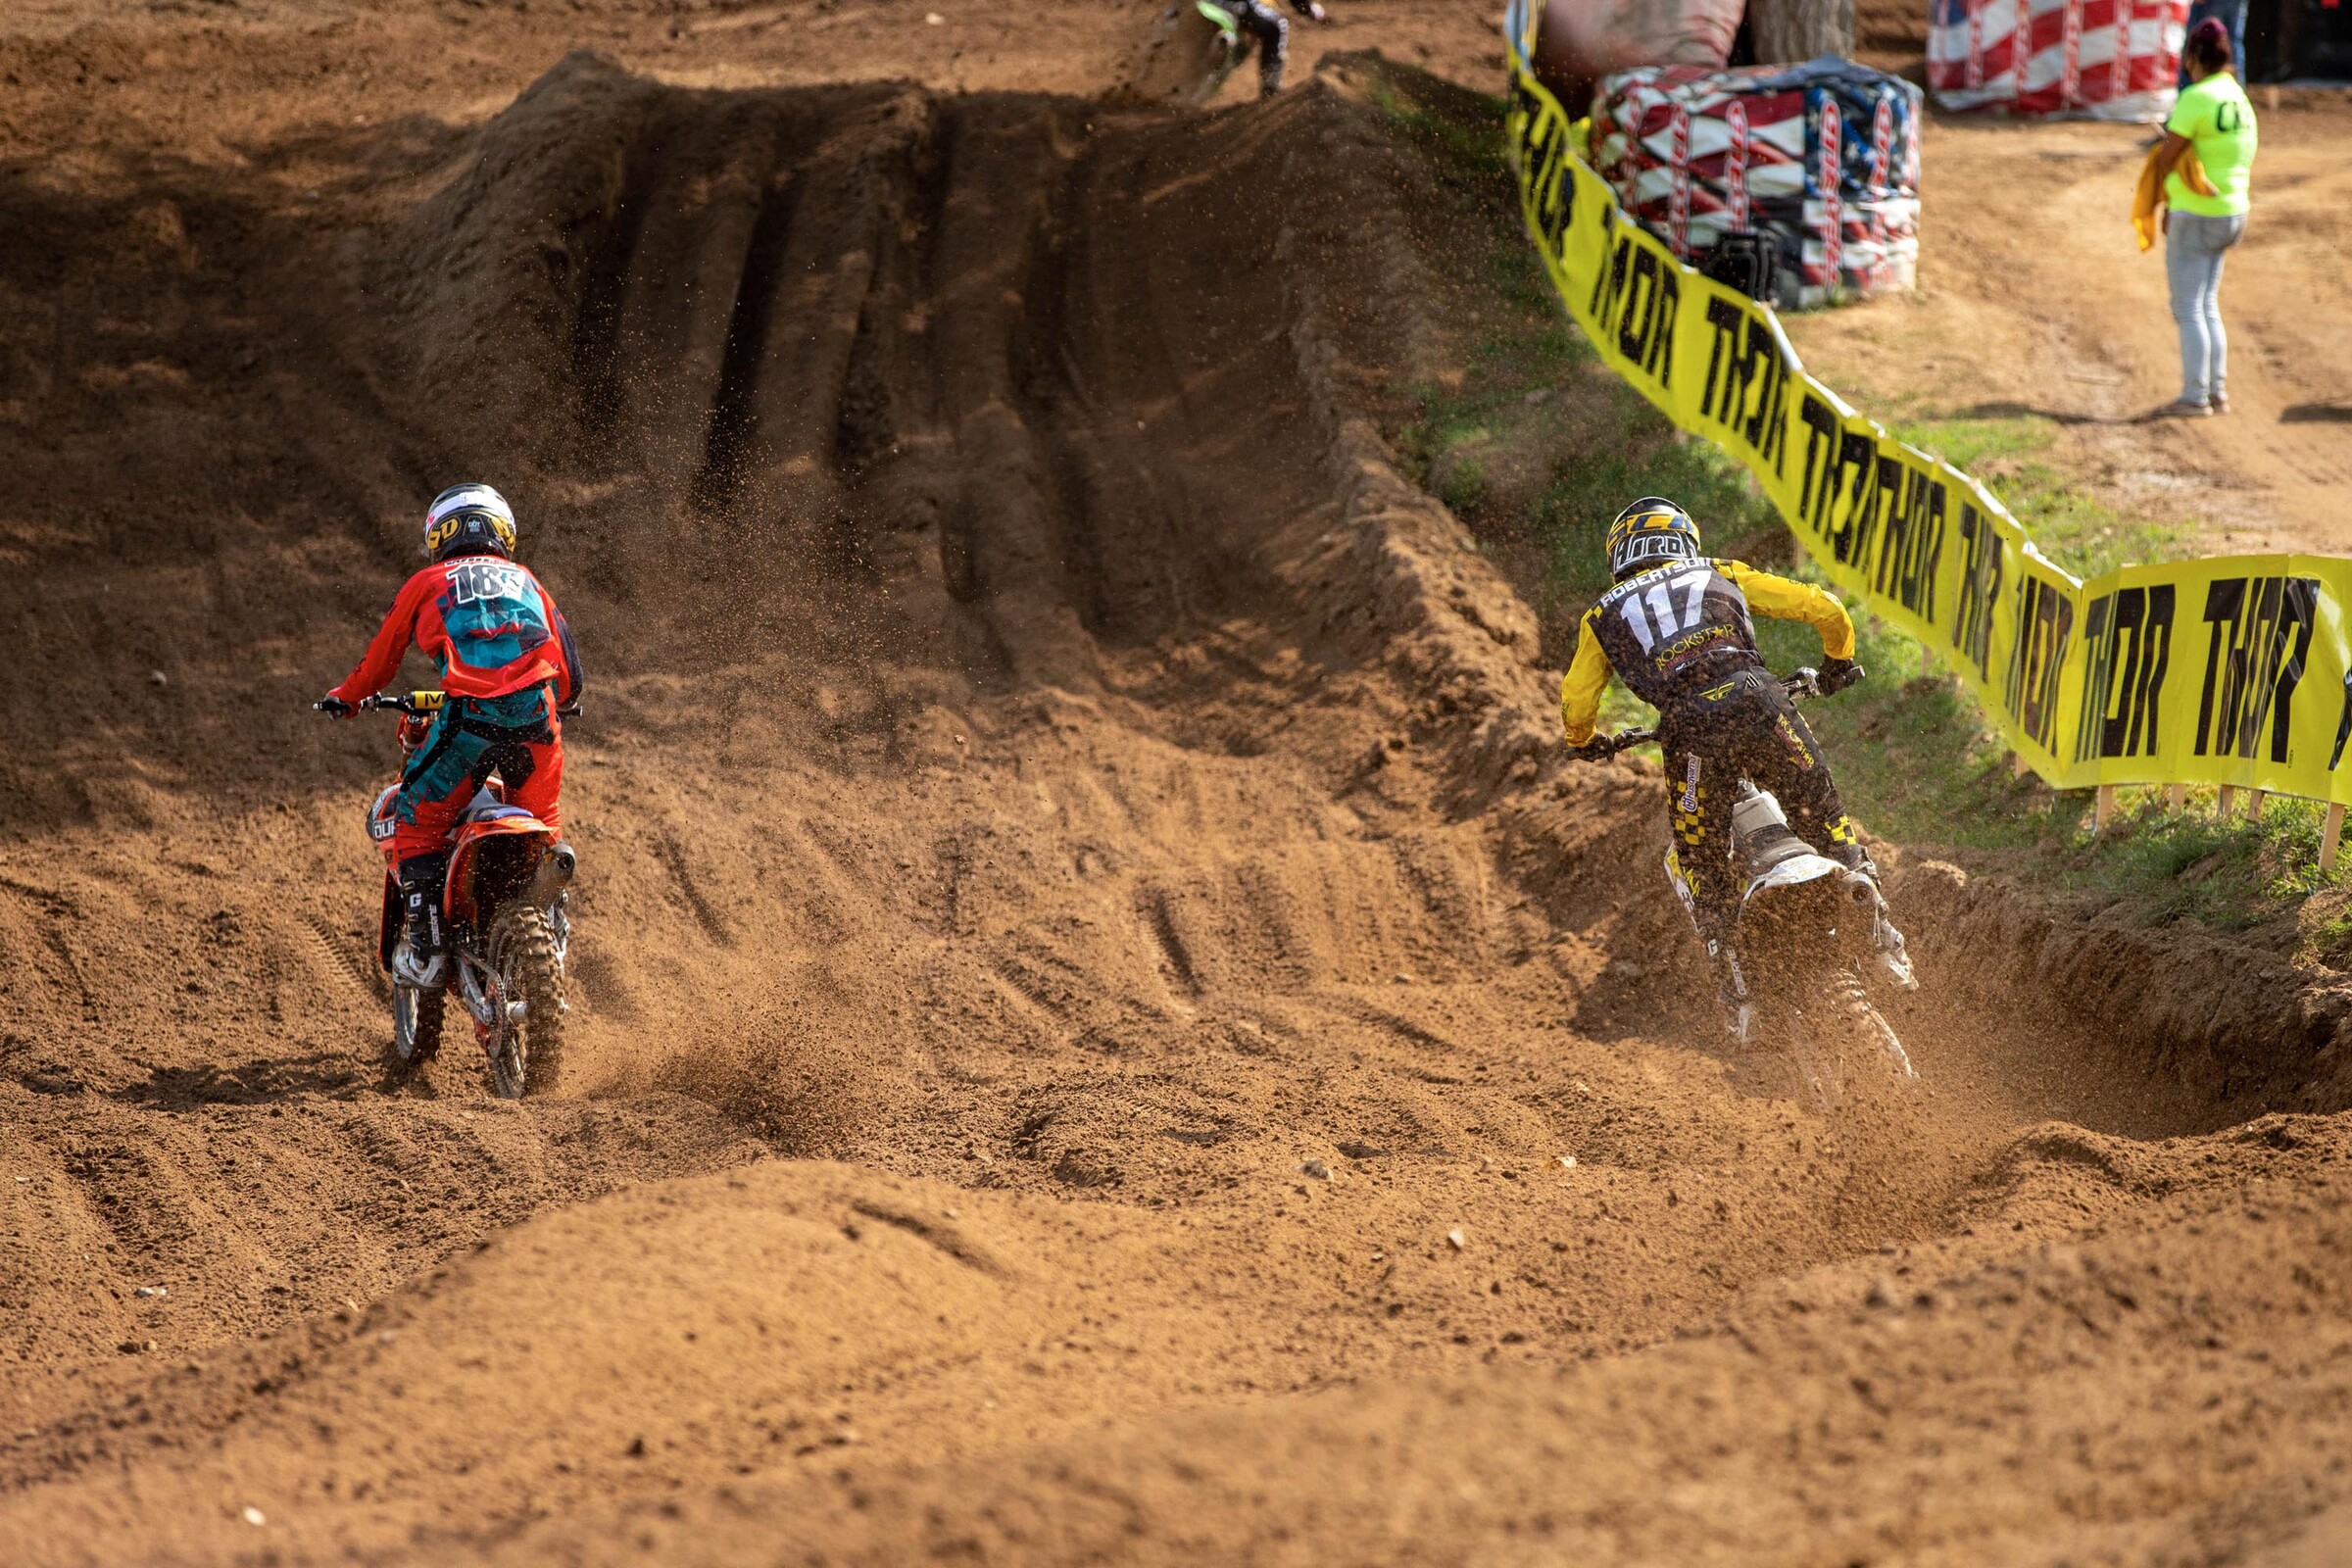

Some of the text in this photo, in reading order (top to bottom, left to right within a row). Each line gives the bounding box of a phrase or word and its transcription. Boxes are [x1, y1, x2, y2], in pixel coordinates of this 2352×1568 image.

[1600, 557, 1711, 608] ROBERTSON
[1620, 569, 1712, 657] 117
[2073, 583, 2176, 763] THOR
[2194, 576, 2321, 763] THOR
